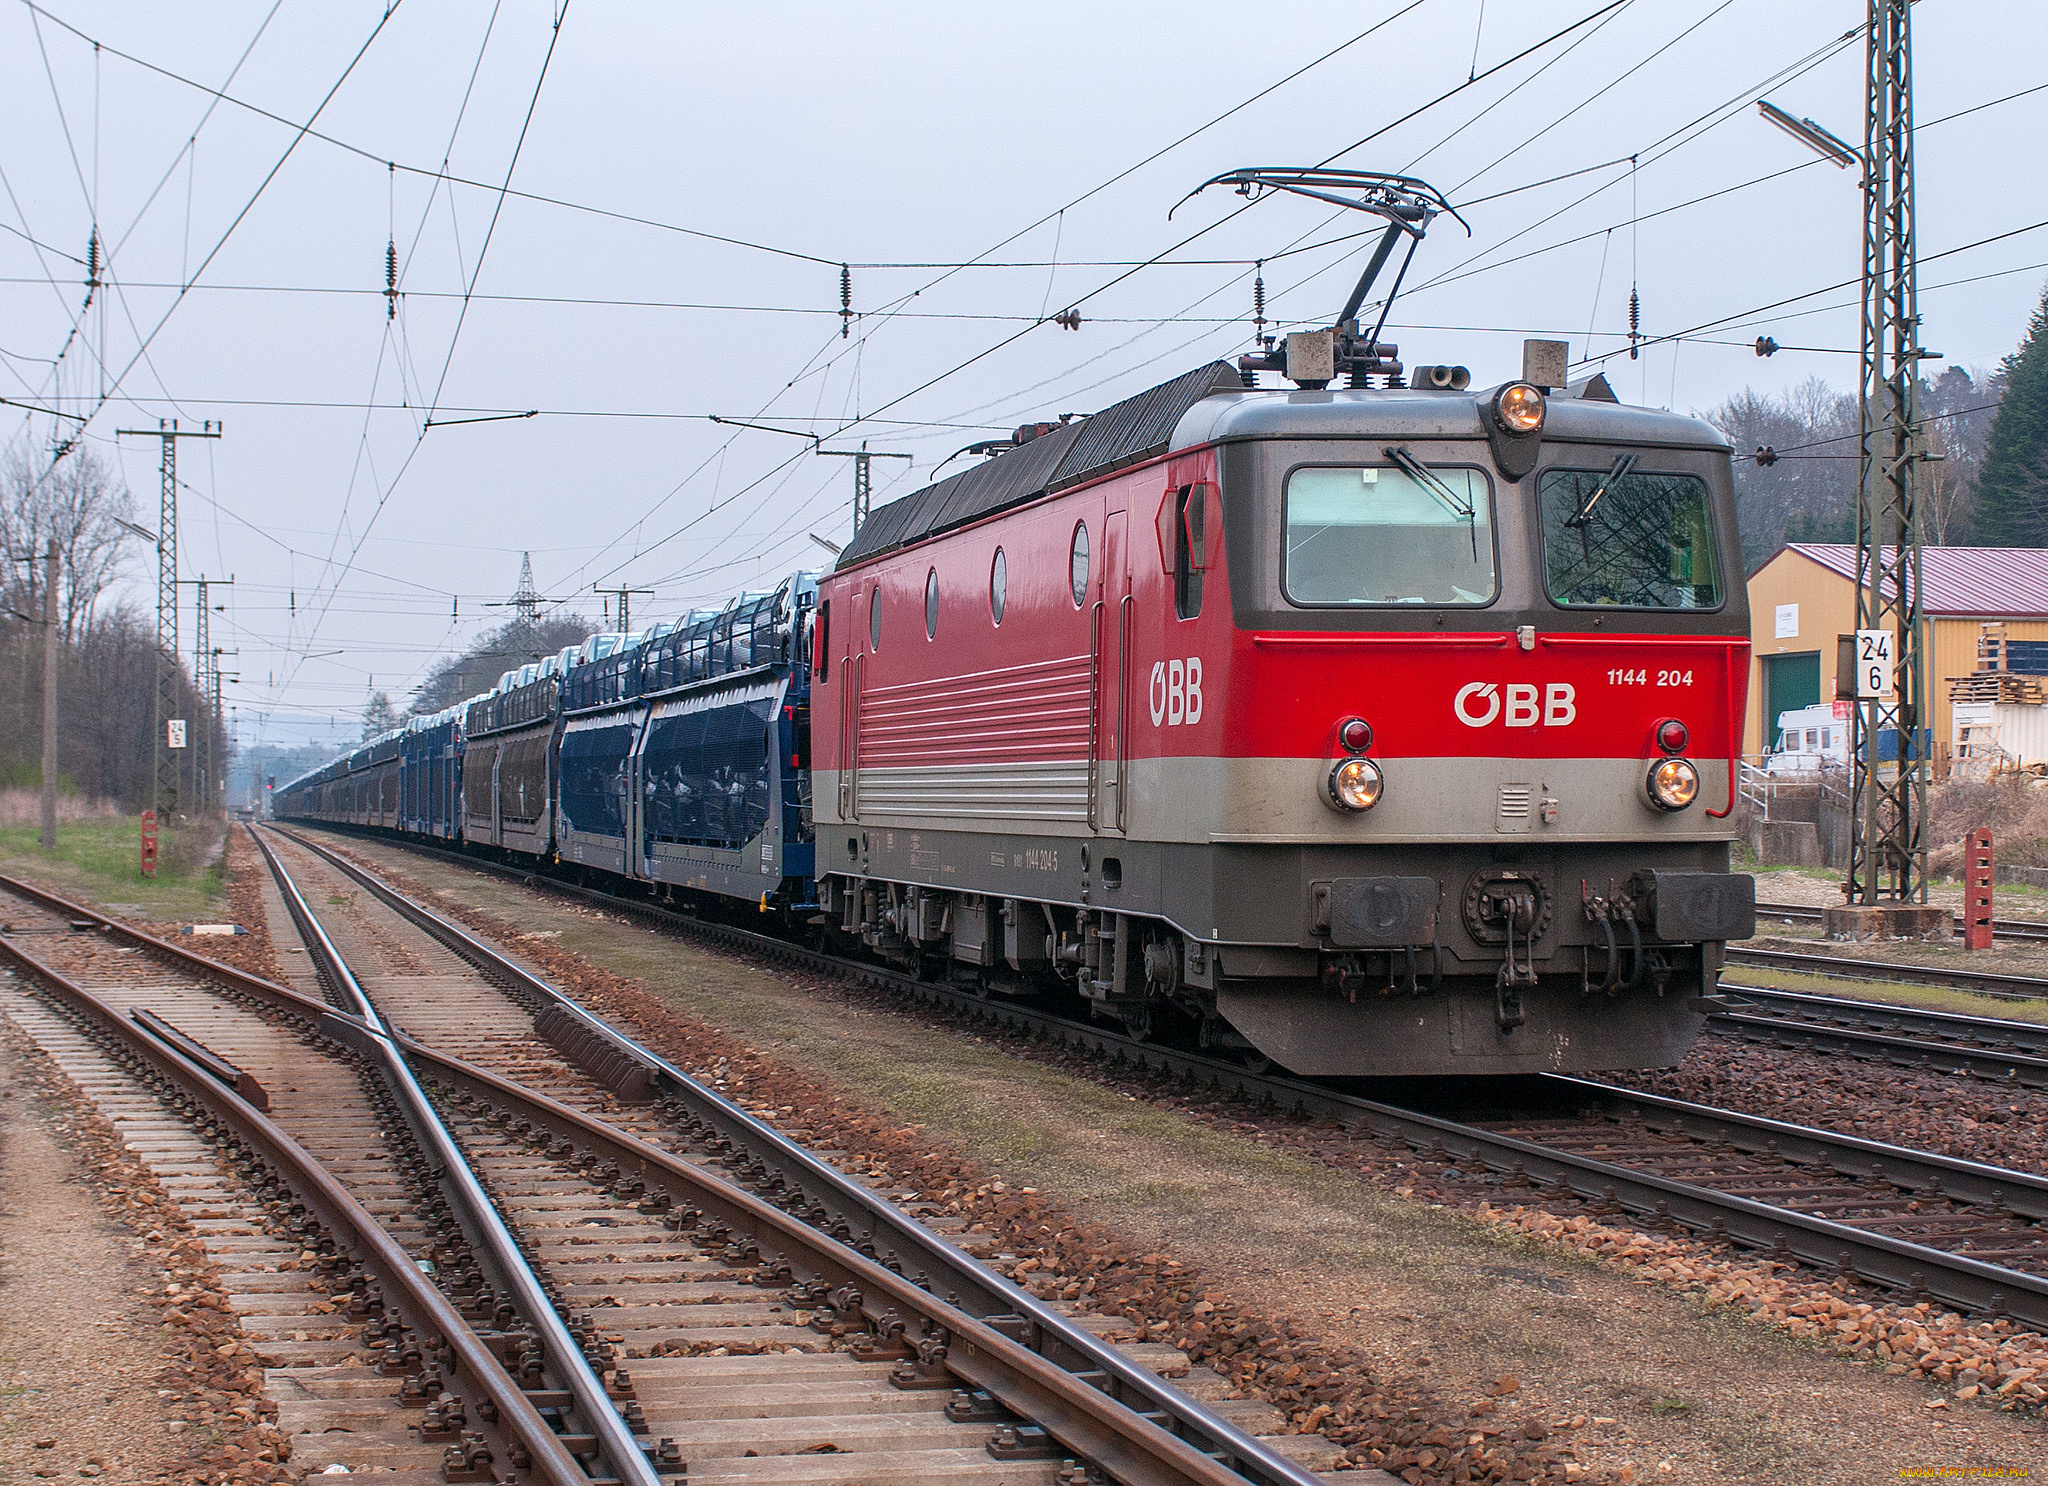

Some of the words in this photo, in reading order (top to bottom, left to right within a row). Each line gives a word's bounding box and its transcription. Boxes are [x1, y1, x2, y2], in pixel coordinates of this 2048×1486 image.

[1862, 636, 1888, 660] 24
[1607, 668, 1647, 686] 1144
[1656, 670, 1693, 687] 204
[1870, 666, 1881, 690] 6
[171, 722, 184, 733] 24
[174, 734, 181, 745] 5
